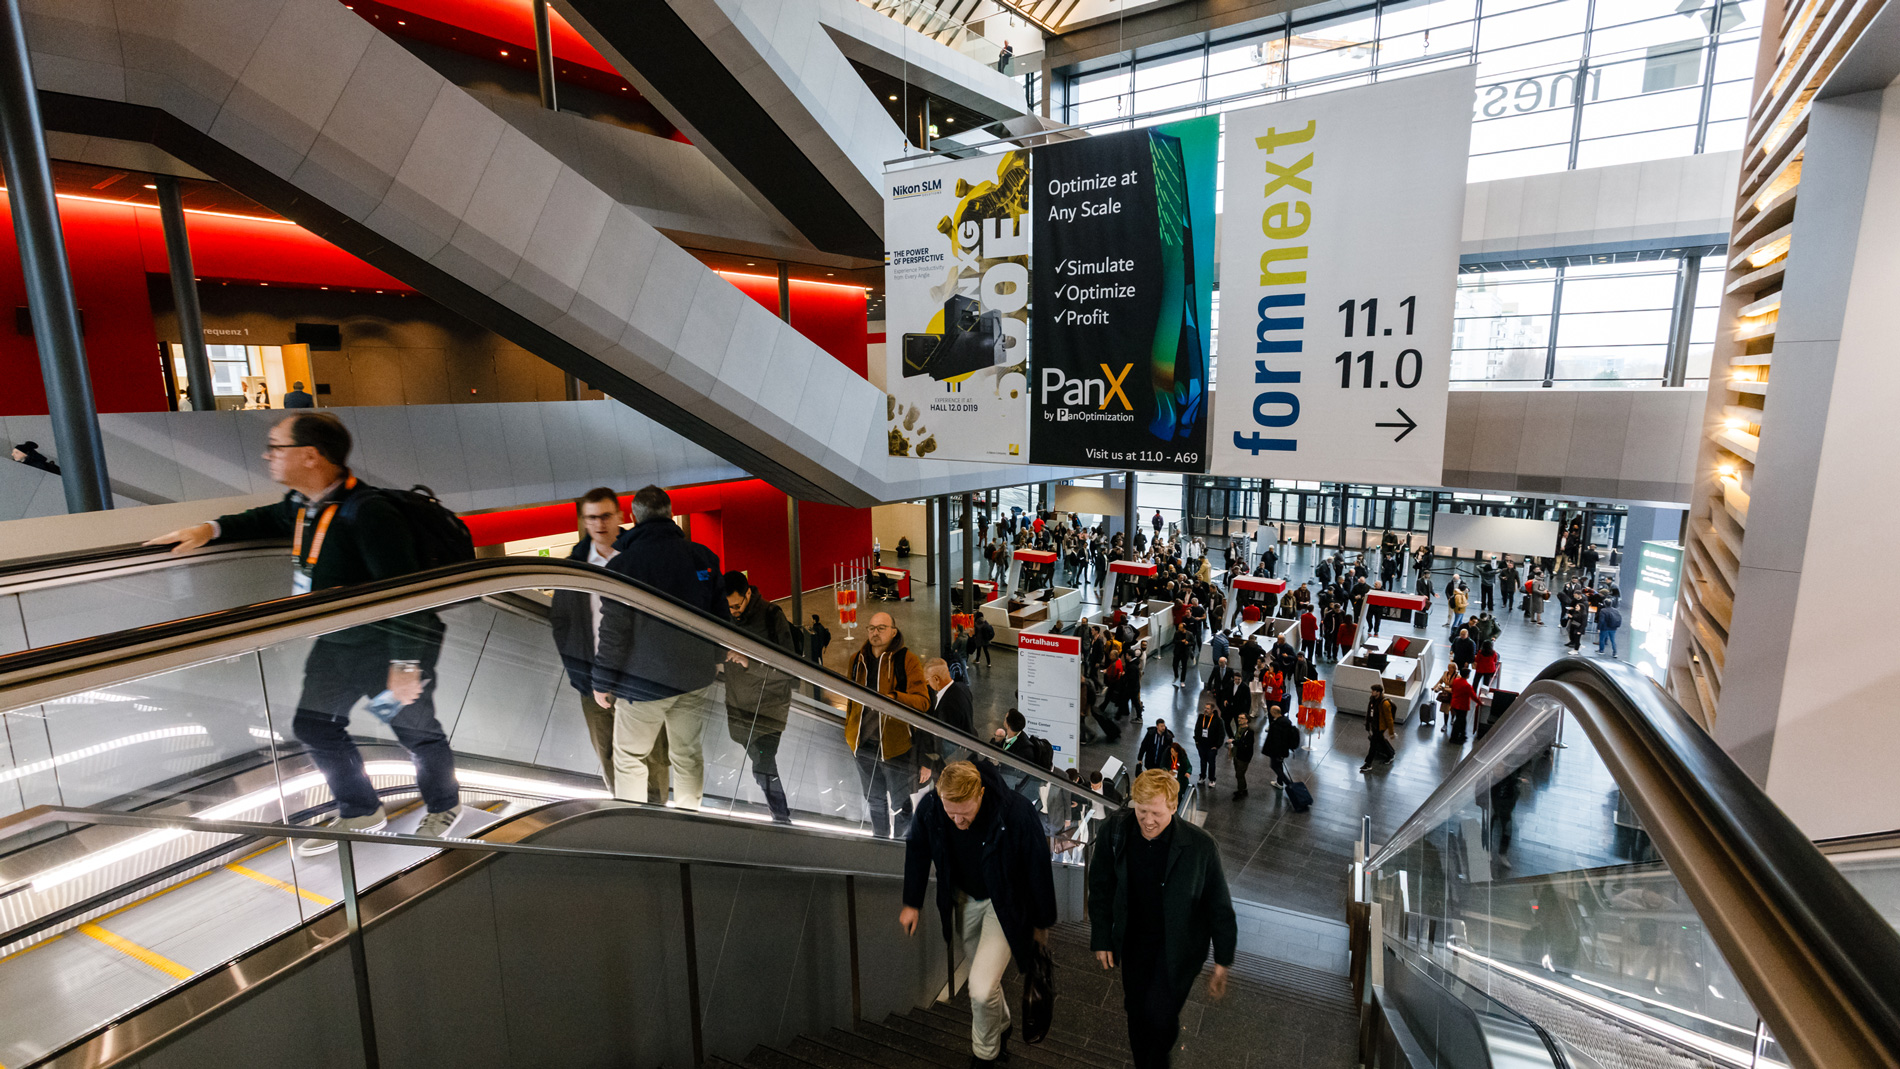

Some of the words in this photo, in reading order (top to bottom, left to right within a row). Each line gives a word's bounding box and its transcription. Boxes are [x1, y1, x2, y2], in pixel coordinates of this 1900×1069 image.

[892, 185, 921, 197] Nikon
[921, 178, 942, 191] SLM
[1048, 173, 1117, 198] Optimize
[1120, 170, 1138, 186] at
[1048, 205, 1077, 223] Any
[1080, 197, 1122, 218] Scale
[893, 250, 905, 258] THE
[905, 247, 929, 257] POWER
[893, 258, 901, 266] OF
[902, 253, 944, 265] PERSPECTIVE
[1067, 256, 1135, 276] Simulate
[1066, 283, 1136, 304] Optimize
[1233, 119, 1316, 456] formnext
[1067, 308, 1110, 326] Profit
[1338, 295, 1416, 338] 11.1
[203, 328, 242, 336] requenz
[244, 328, 249, 336] 1
[1335, 349, 1423, 389] 11.0
[1041, 363, 1134, 411] PanX
[930, 404, 948, 412] HALL
[948, 404, 962, 412] 12.0
[963, 404, 979, 412] D119
[1044, 410, 1055, 421] by
[1056, 408, 1134, 422] PanOptimization
[1085, 448, 1109, 460] Visit
[1111, 451, 1123, 460] us
[1125, 451, 1137, 461] at
[1139, 451, 1163, 462] 11.0
[1174, 452, 1198, 464] A69
[1020, 635, 1060, 647] Portalhaus
